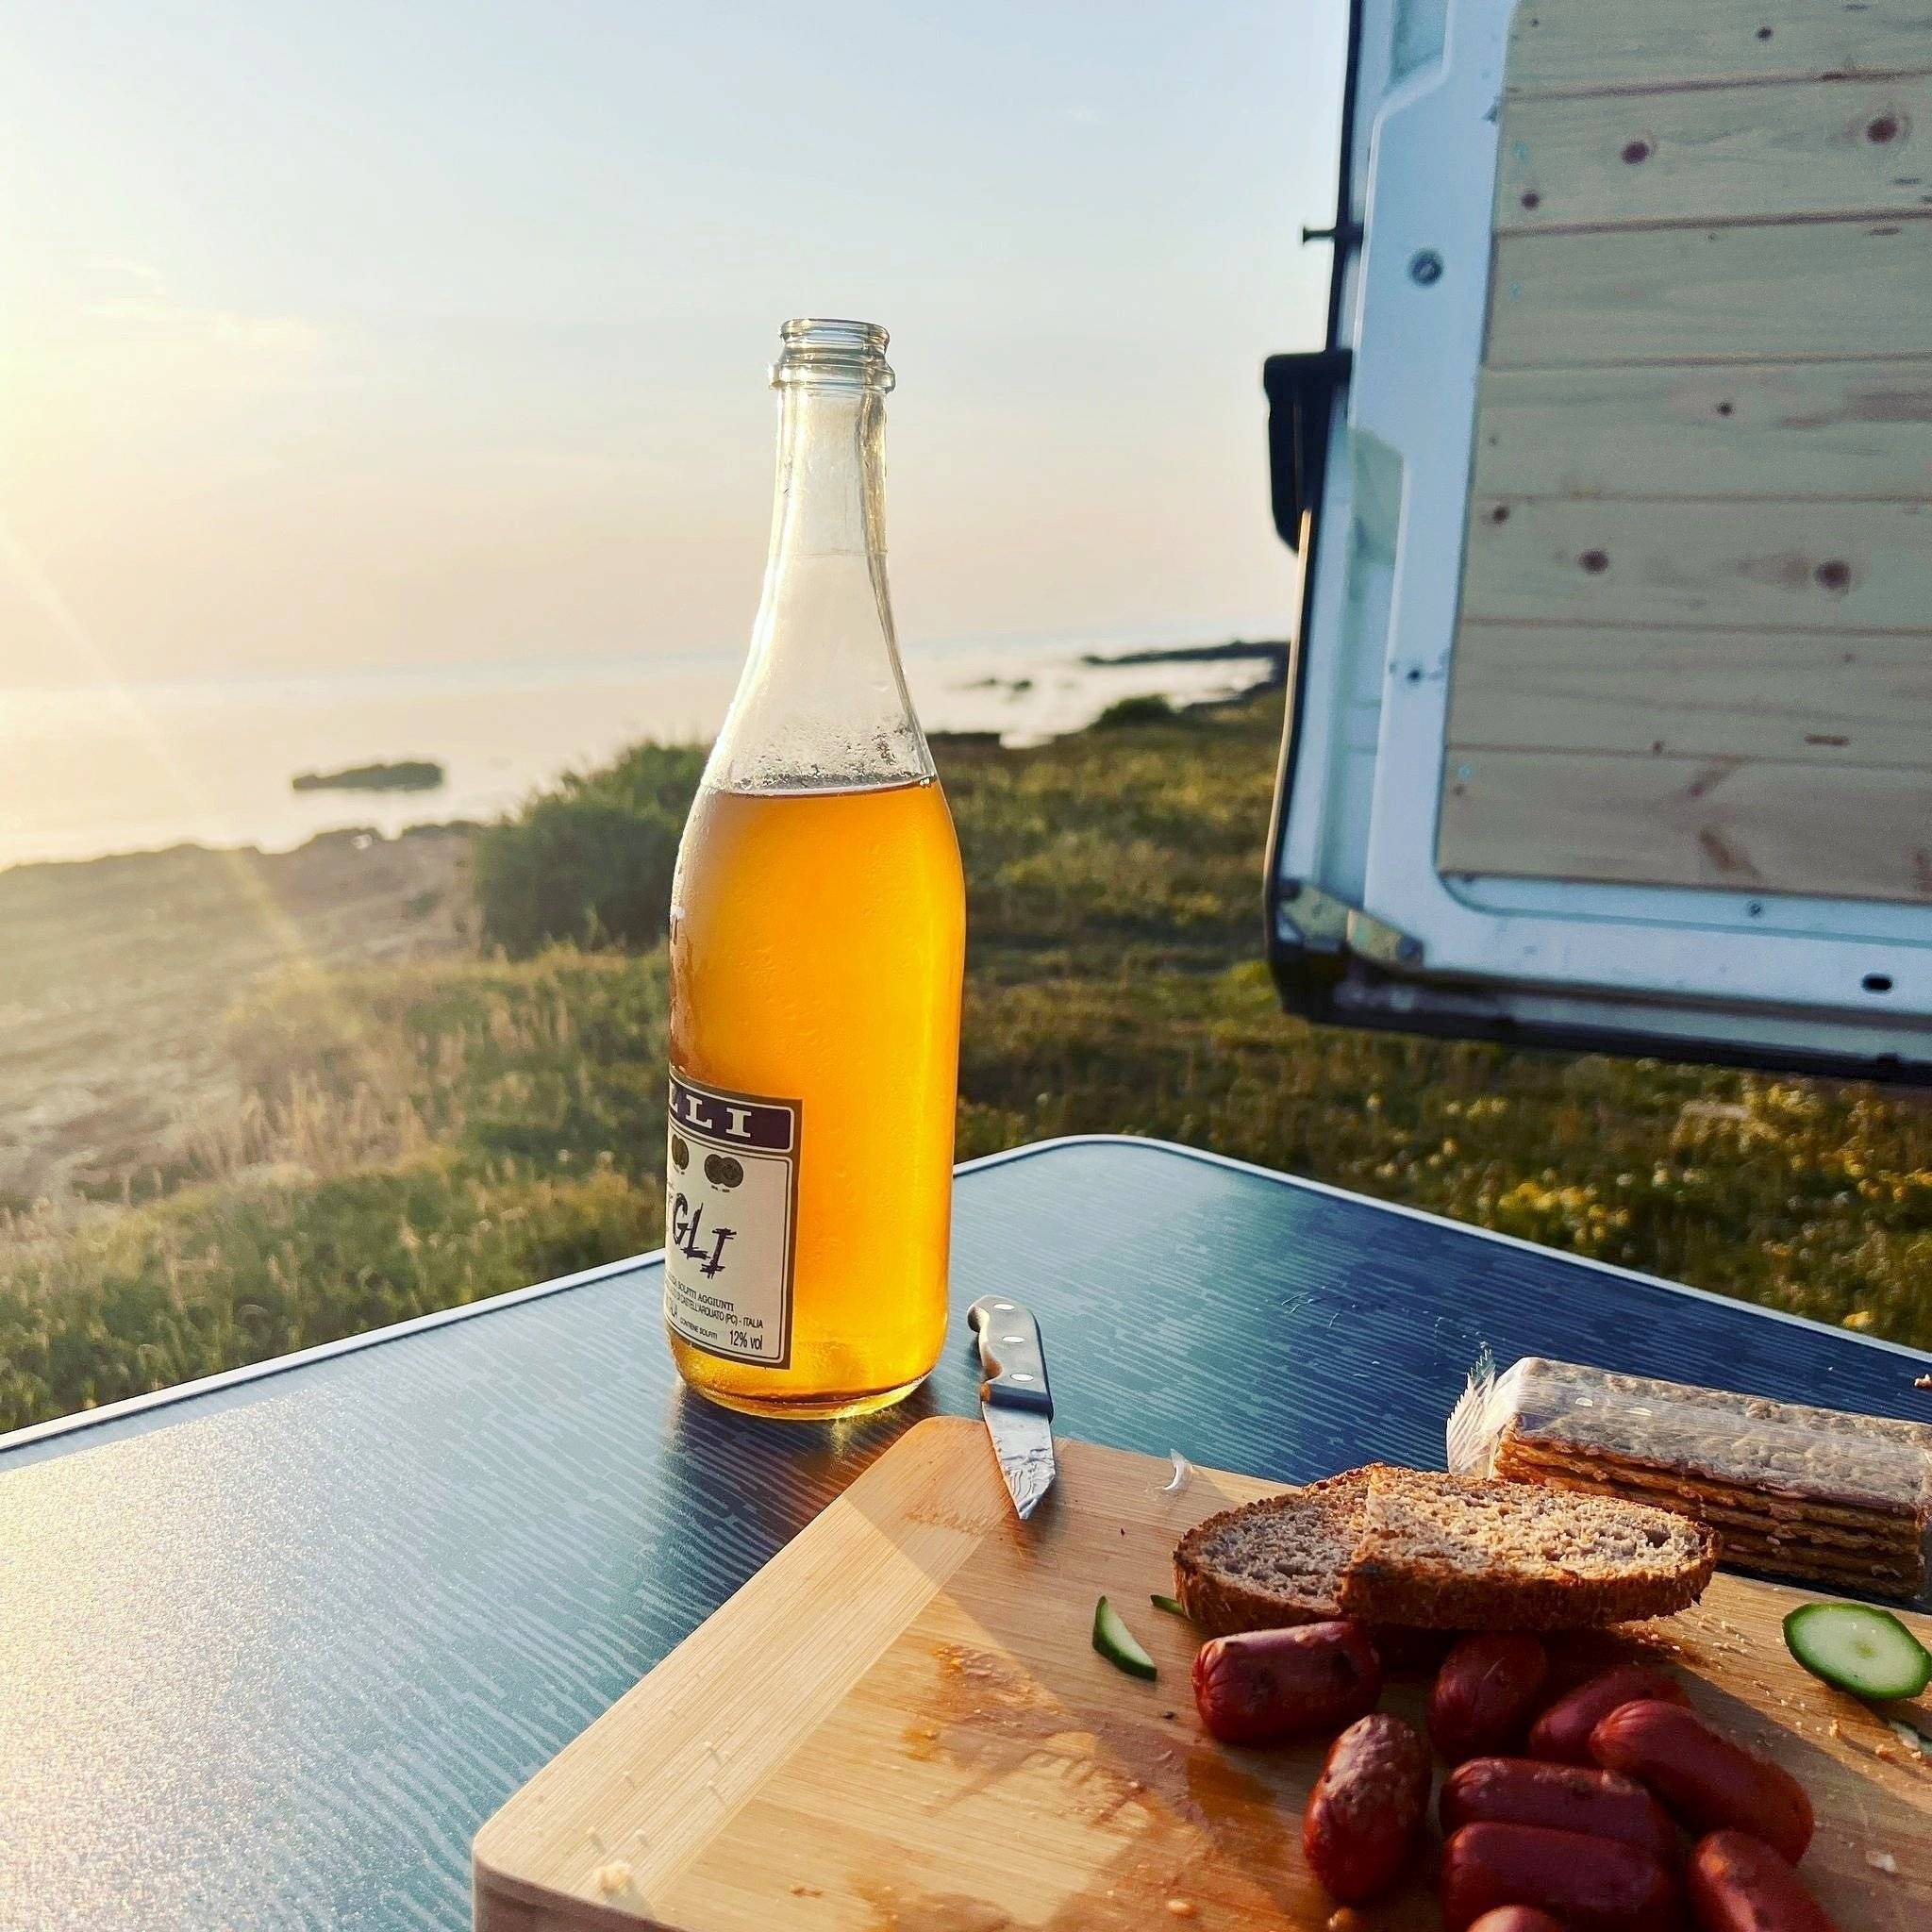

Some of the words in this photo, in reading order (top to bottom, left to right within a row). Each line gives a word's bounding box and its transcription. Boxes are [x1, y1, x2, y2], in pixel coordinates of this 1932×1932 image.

[697, 1292, 734, 1312] AGGIUNTI
[679, 1317, 699, 1333] CONTIENE
[699, 1326, 718, 1341] SOLFITI
[743, 1317, 764, 1329] ITALIA
[729, 1330, 748, 1348] 12%
[750, 1335, 763, 1350] vol
